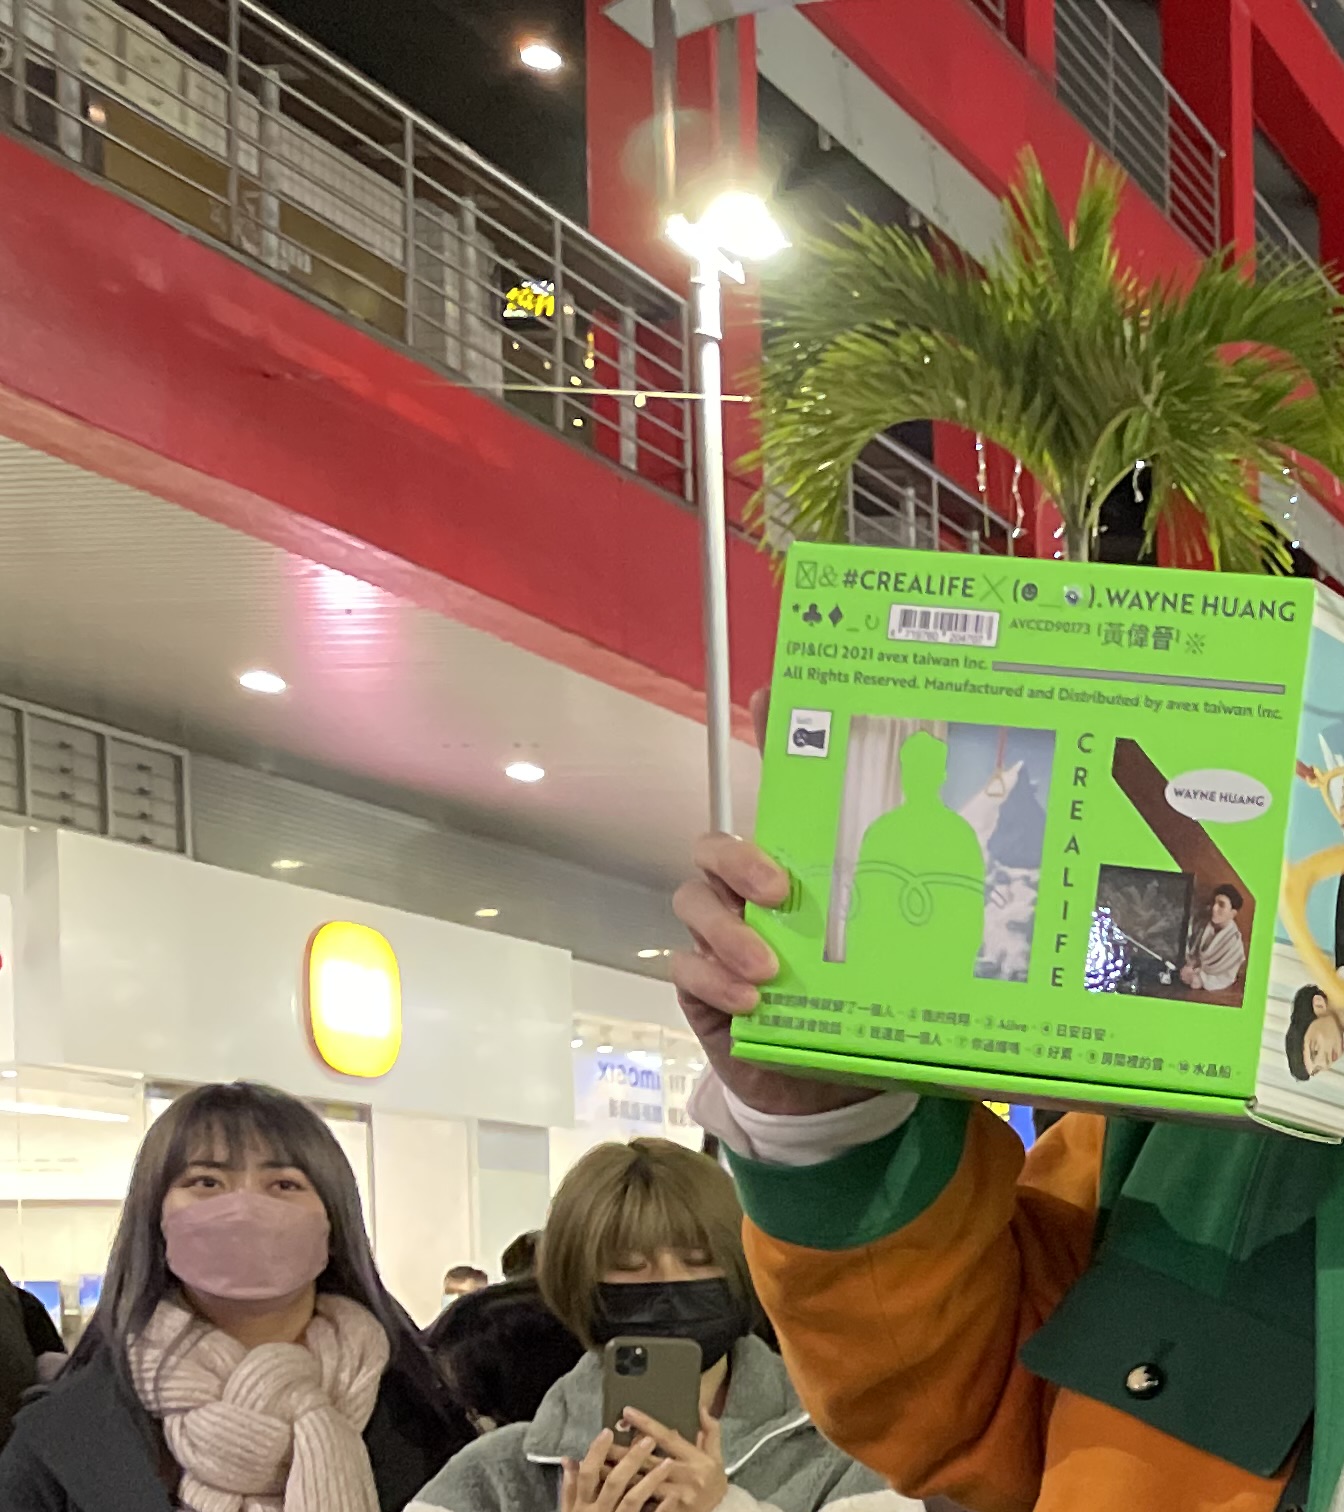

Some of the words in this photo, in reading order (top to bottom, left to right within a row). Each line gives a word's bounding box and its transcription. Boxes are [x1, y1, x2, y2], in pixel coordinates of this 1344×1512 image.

[842, 569, 976, 598] #CREALIFE
[1201, 594, 1296, 622] HUANG
[842, 644, 874, 660] 2021
[877, 651, 909, 665] avex
[912, 652, 960, 669] taiwan
[784, 665, 803, 680] All
[807, 668, 850, 685] Rights
[853, 671, 920, 689] Reserved.
[924, 678, 1024, 697] Manufactured
[1027, 687, 1055, 700] and
[1057, 687, 1140, 708] Distributed
[1144, 694, 1162, 713] by
[1165, 701, 1200, 713] avex
[1203, 700, 1254, 717] taiwan
[1174, 787, 1217, 802] WAYNE
[1219, 791, 1265, 807] HUANG
[1051, 732, 1095, 988] CREALIFE
